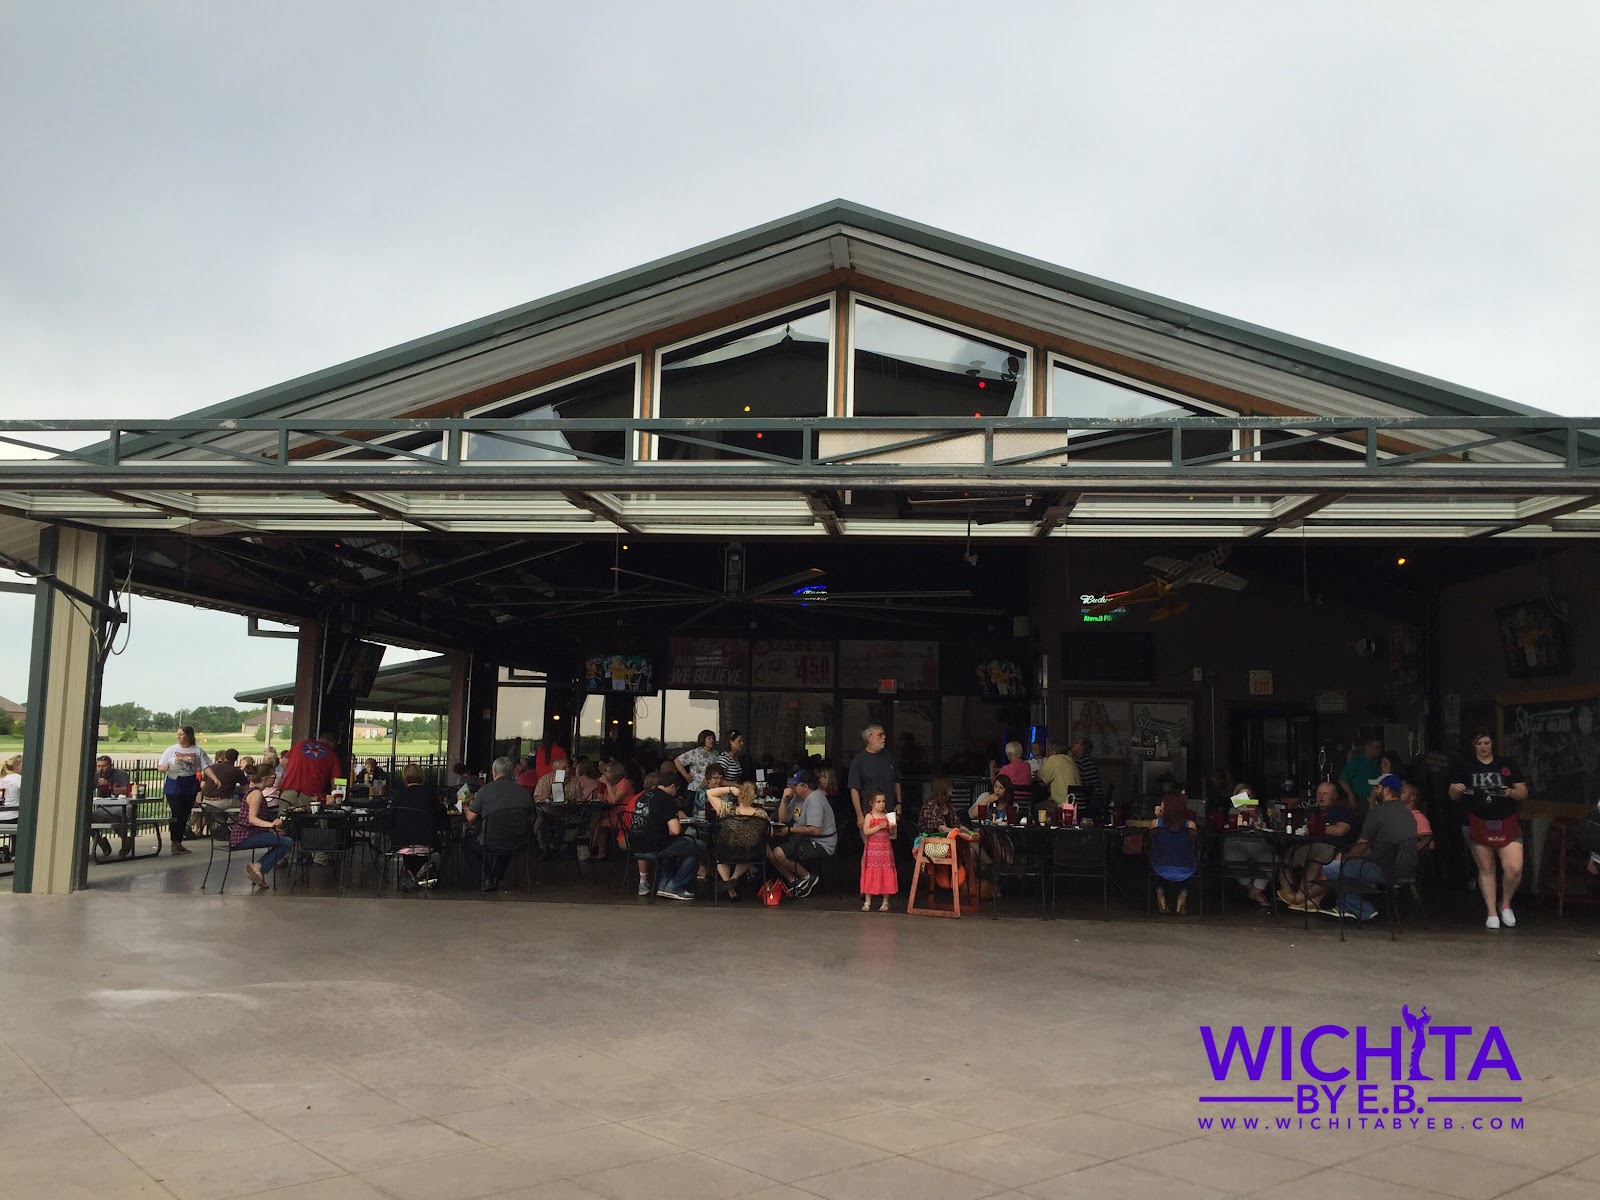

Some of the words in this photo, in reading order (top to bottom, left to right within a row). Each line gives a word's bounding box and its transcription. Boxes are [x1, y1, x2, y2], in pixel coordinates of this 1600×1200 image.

[672, 669, 693, 684] WE
[694, 669, 744, 686] BELIEVE
[1254, 681, 1269, 693] EXIT
